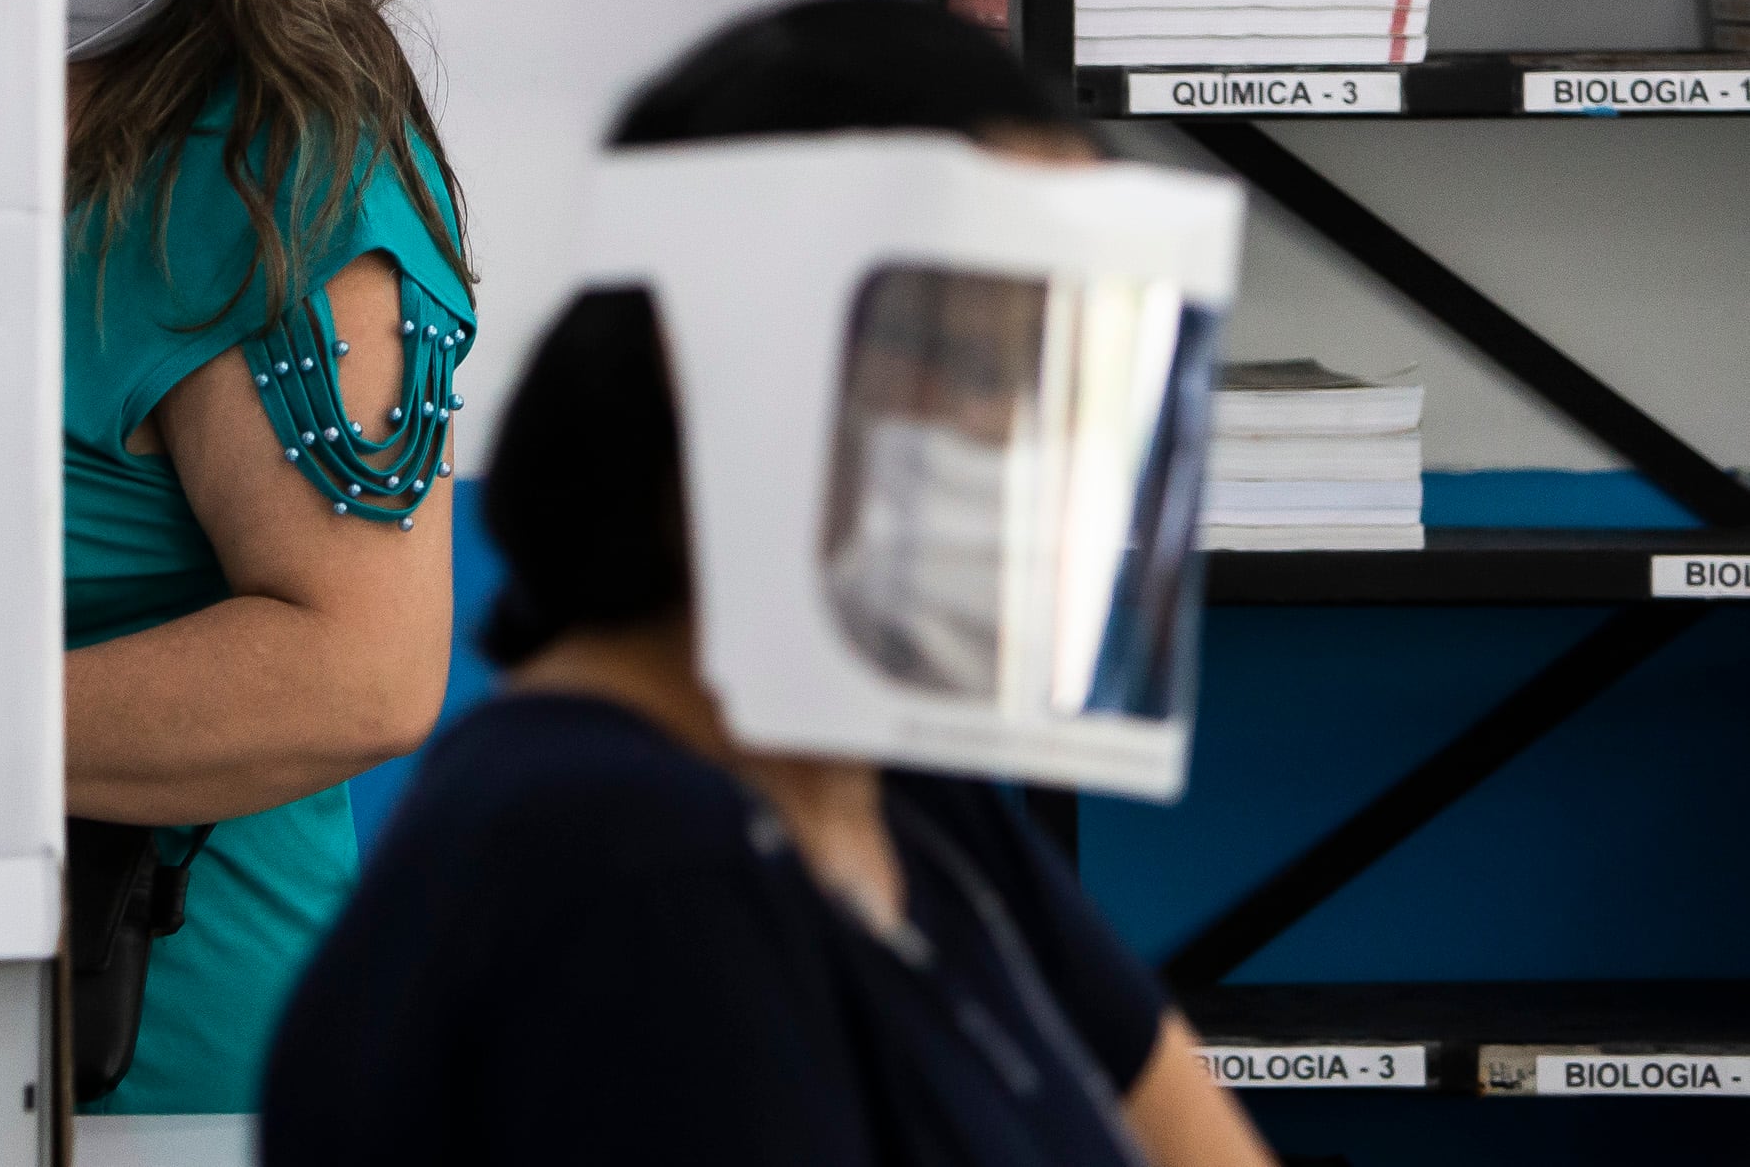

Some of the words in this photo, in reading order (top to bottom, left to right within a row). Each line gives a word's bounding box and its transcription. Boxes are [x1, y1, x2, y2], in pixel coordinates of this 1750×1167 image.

[1172, 74, 1312, 107] QUÍMICA
[1342, 81, 1358, 104] 3
[1553, 78, 1710, 105] BIOLOGIA
[1378, 1054, 1395, 1080] 3
[1564, 1062, 1721, 1088] BIOLOGIA
